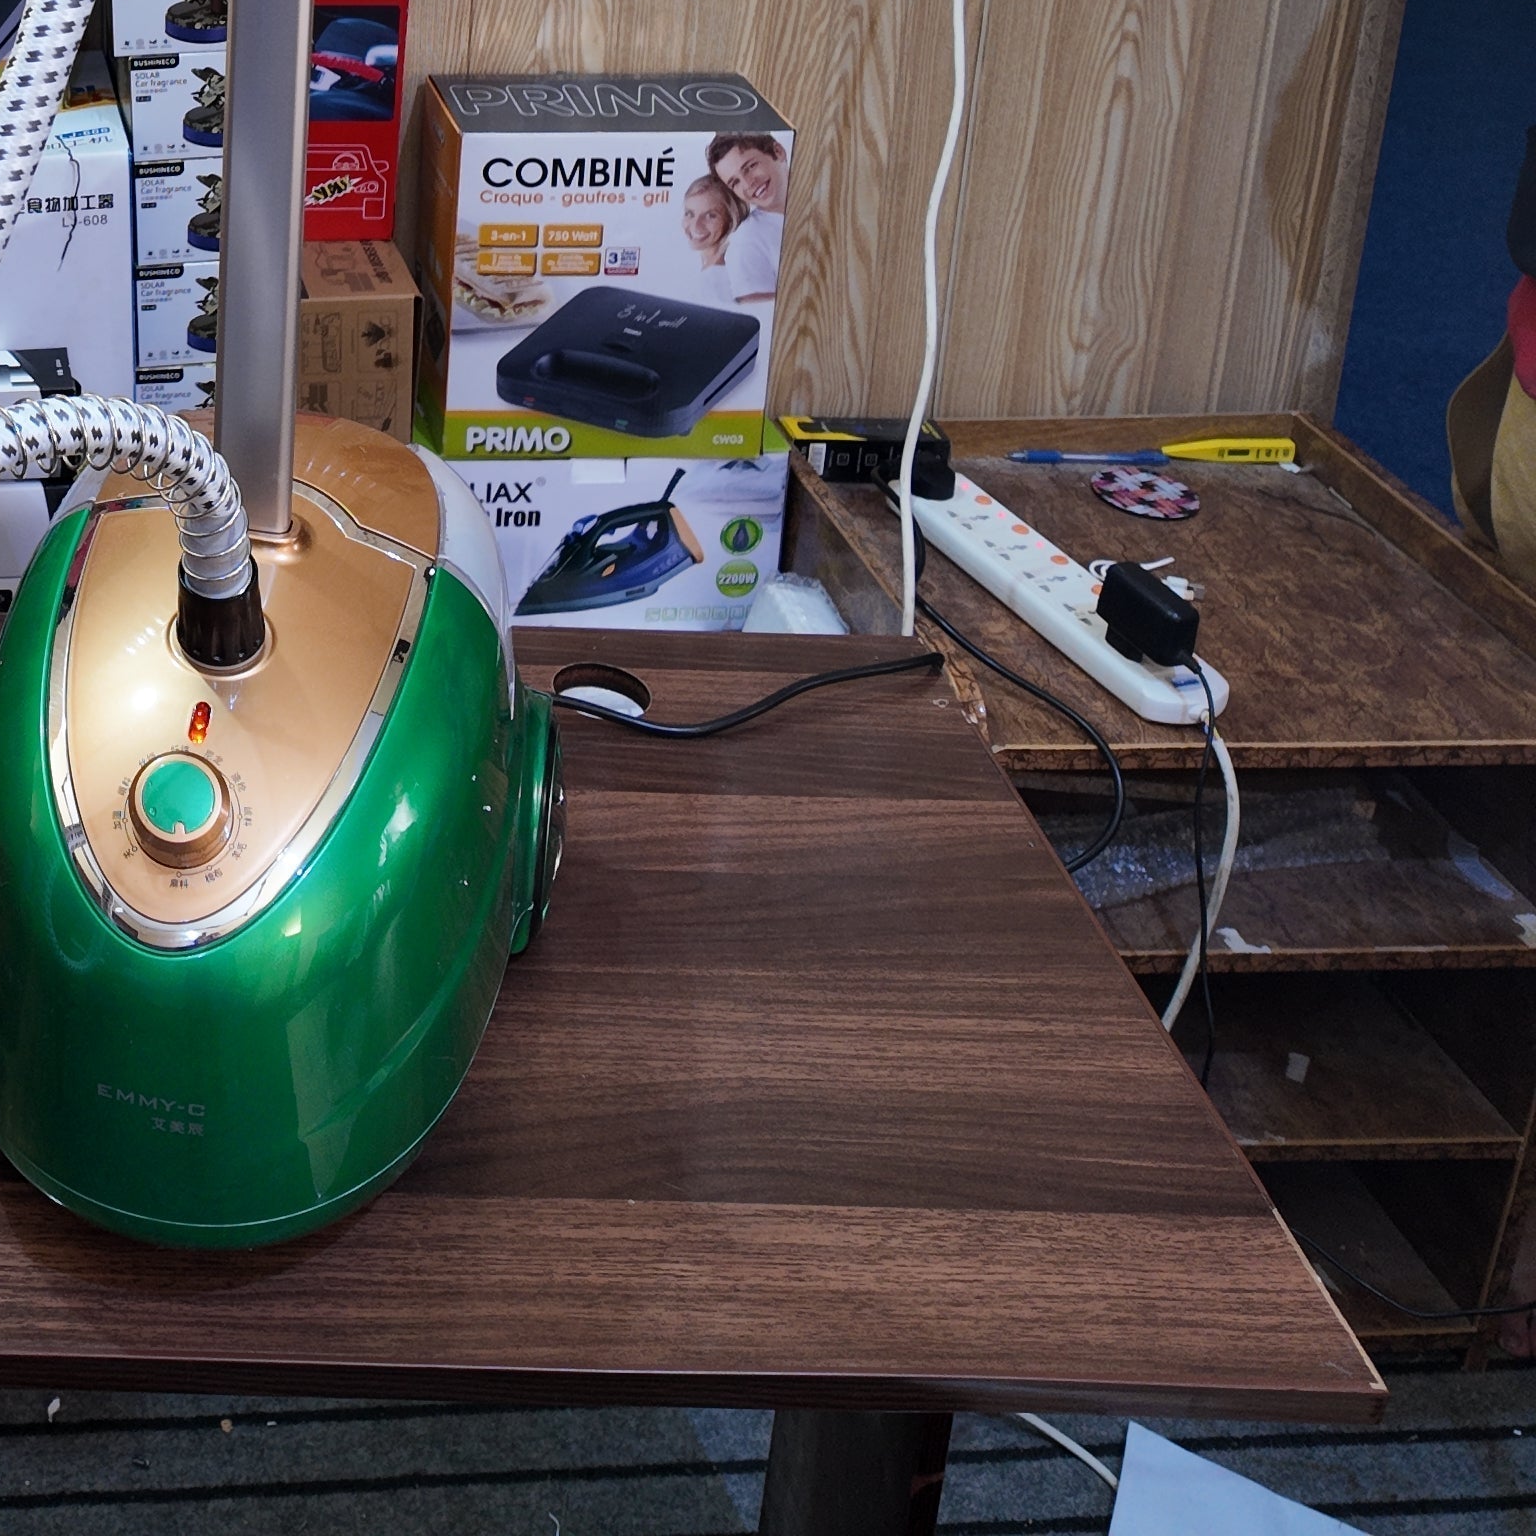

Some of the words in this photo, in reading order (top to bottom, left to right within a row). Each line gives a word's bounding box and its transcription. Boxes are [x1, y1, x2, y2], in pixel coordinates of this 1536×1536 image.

[450, 81, 758, 117] PRIMO
[482, 147, 675, 188] COMBINÉ
[22, 193, 114, 214] 食物加工器
[479, 189, 544, 206] Croque
[562, 190, 626, 207] gaufres
[643, 190, 670, 207] gril
[547, 230, 569, 241] 750
[607, 251, 618, 264] 3
[465, 426, 571, 454] PRIMO
[712, 434, 744, 446] CW03
[495, 507, 542, 528] Iron
[717, 573, 757, 585] 2200W
[96, 1082, 206, 1117] EMMY-C
